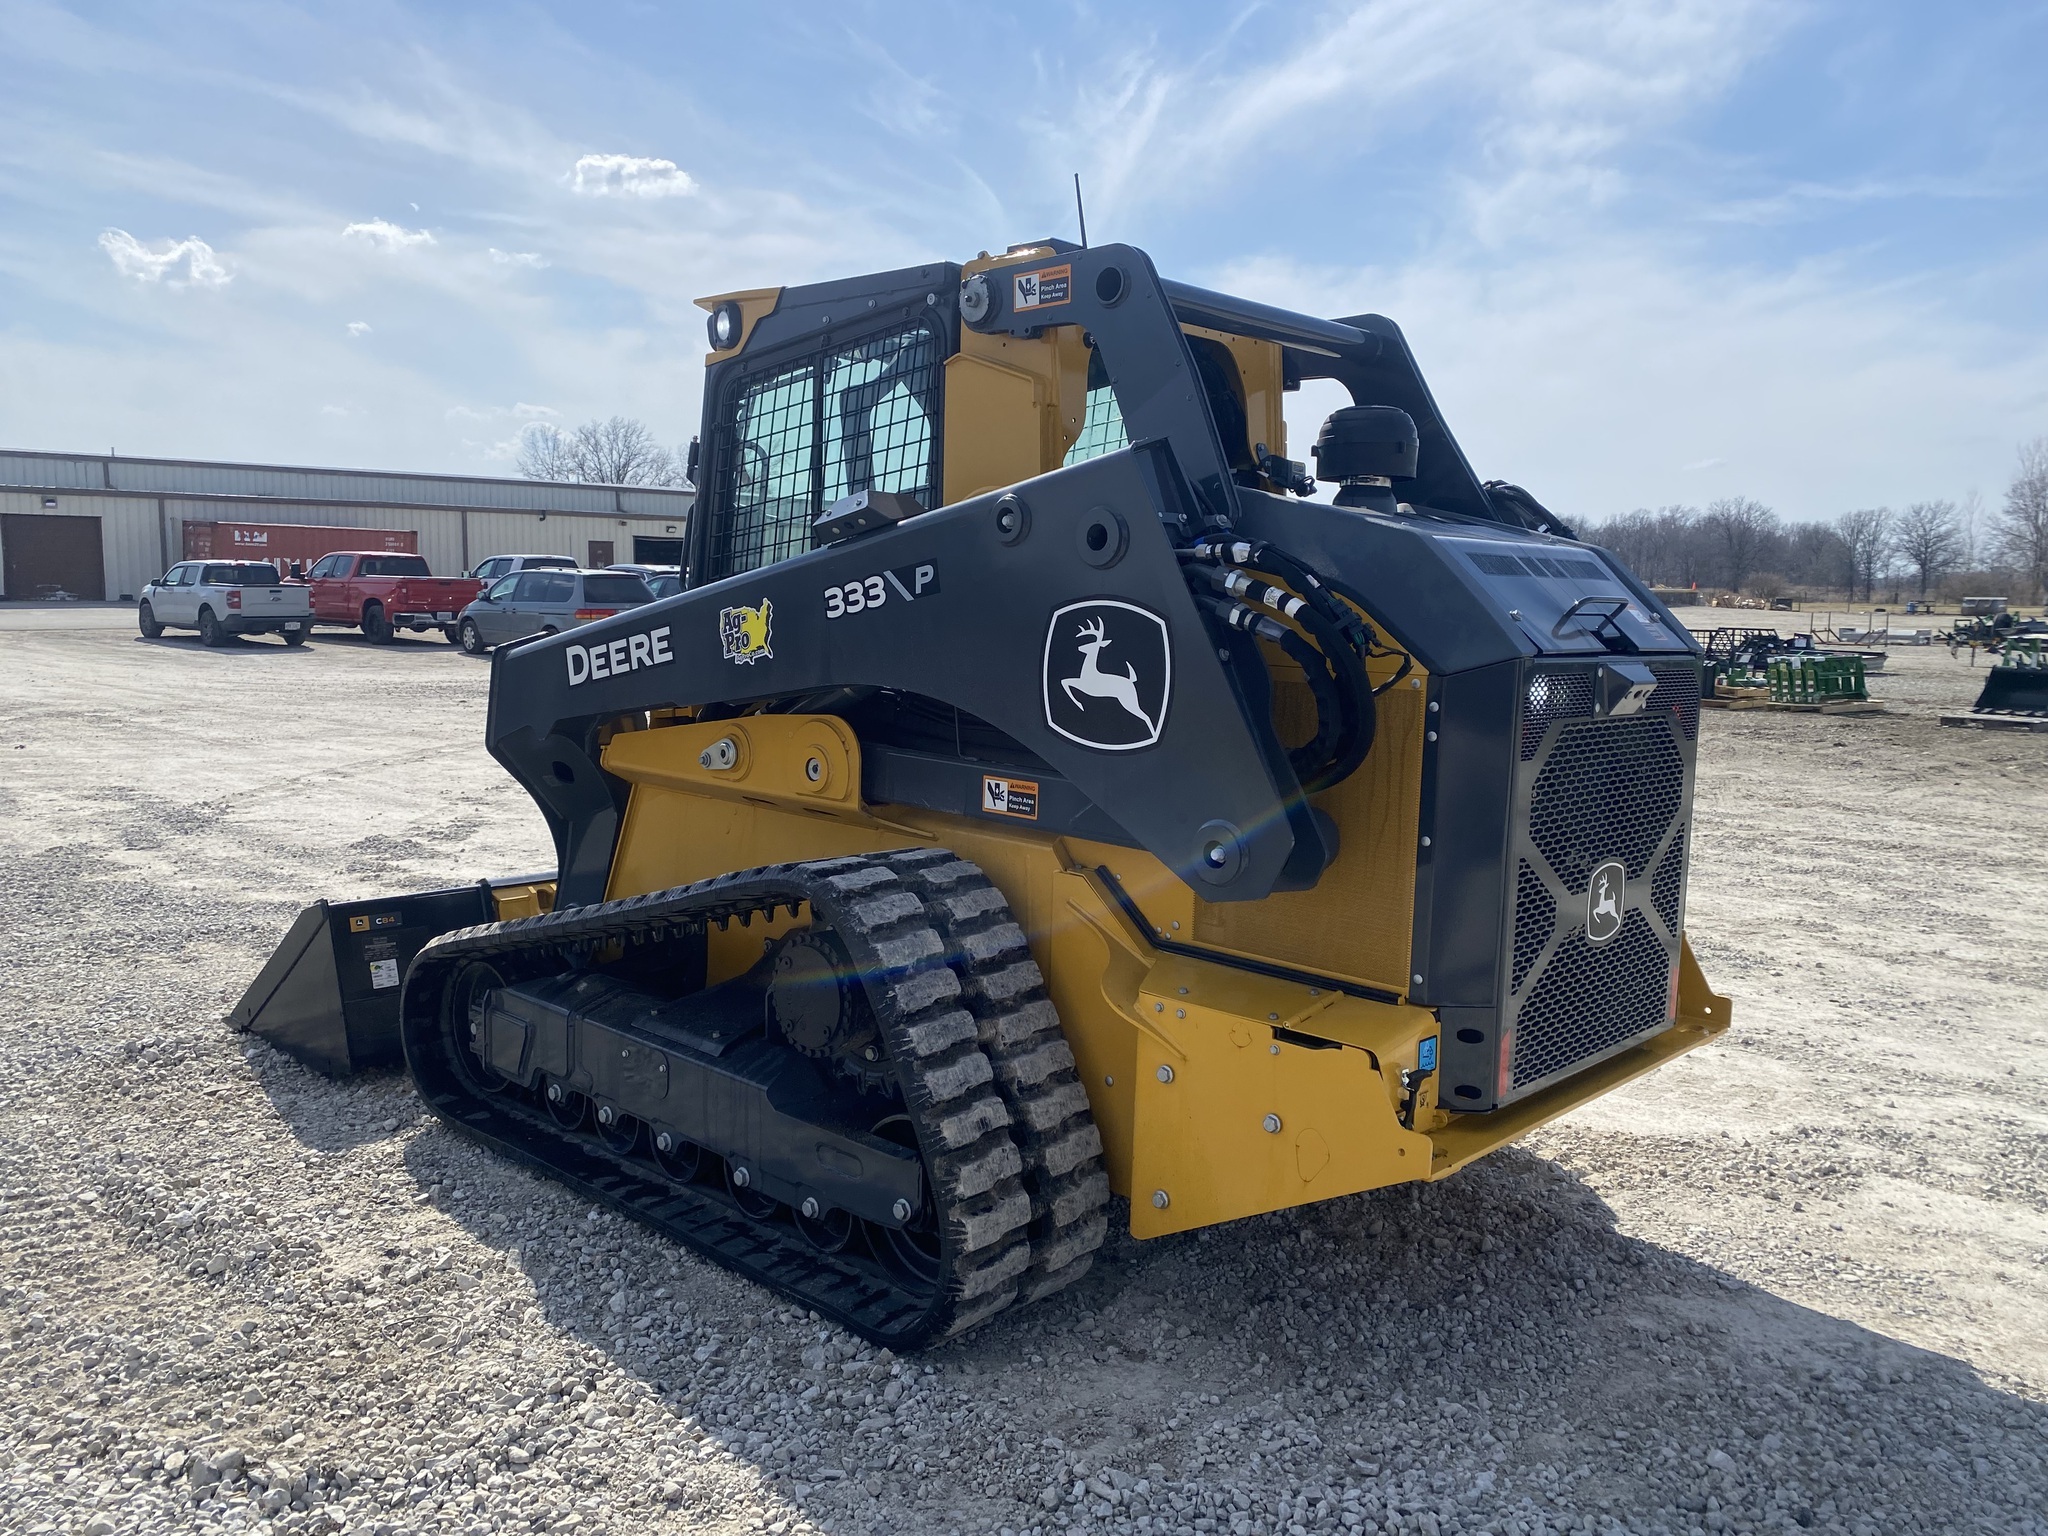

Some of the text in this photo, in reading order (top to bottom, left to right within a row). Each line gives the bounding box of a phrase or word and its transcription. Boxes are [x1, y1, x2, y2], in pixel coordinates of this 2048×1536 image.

[723, 611, 747, 635] Ag-
[725, 632, 750, 654] Pro
[565, 626, 674, 687] DEERE
[1009, 795, 1022, 803] Pinch
[375, 916, 395, 924] C84
